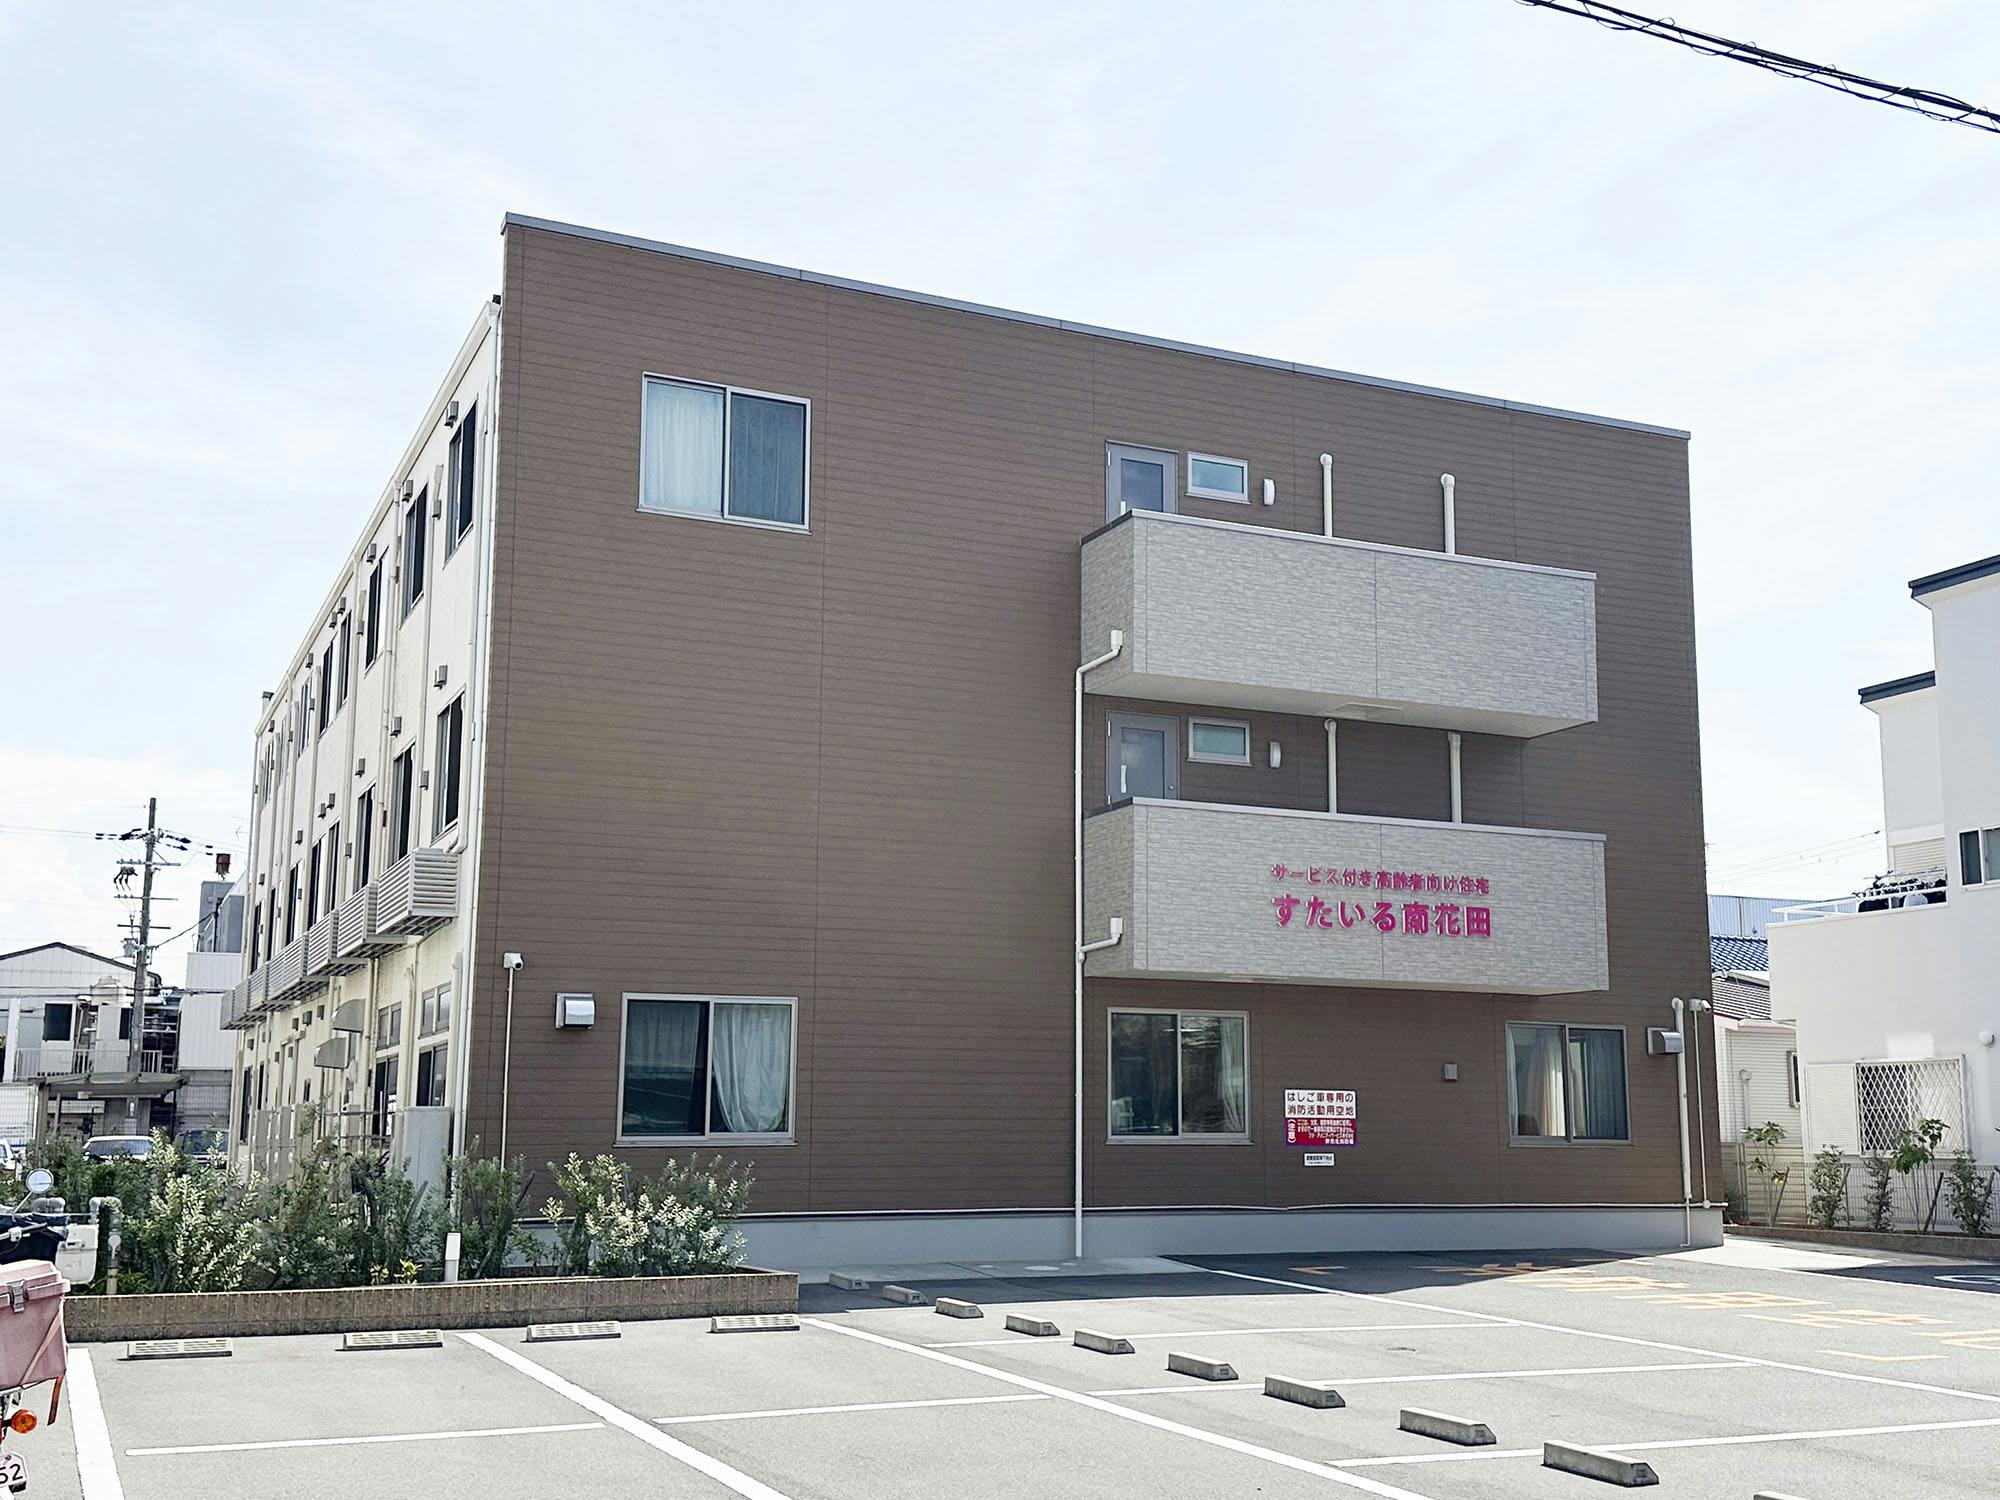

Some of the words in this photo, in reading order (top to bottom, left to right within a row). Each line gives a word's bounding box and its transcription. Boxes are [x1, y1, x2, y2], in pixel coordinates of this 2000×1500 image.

[1271, 864, 1490, 895] サービス付き高齢者向け住宅
[1272, 894, 1492, 937] すたいる南花田
